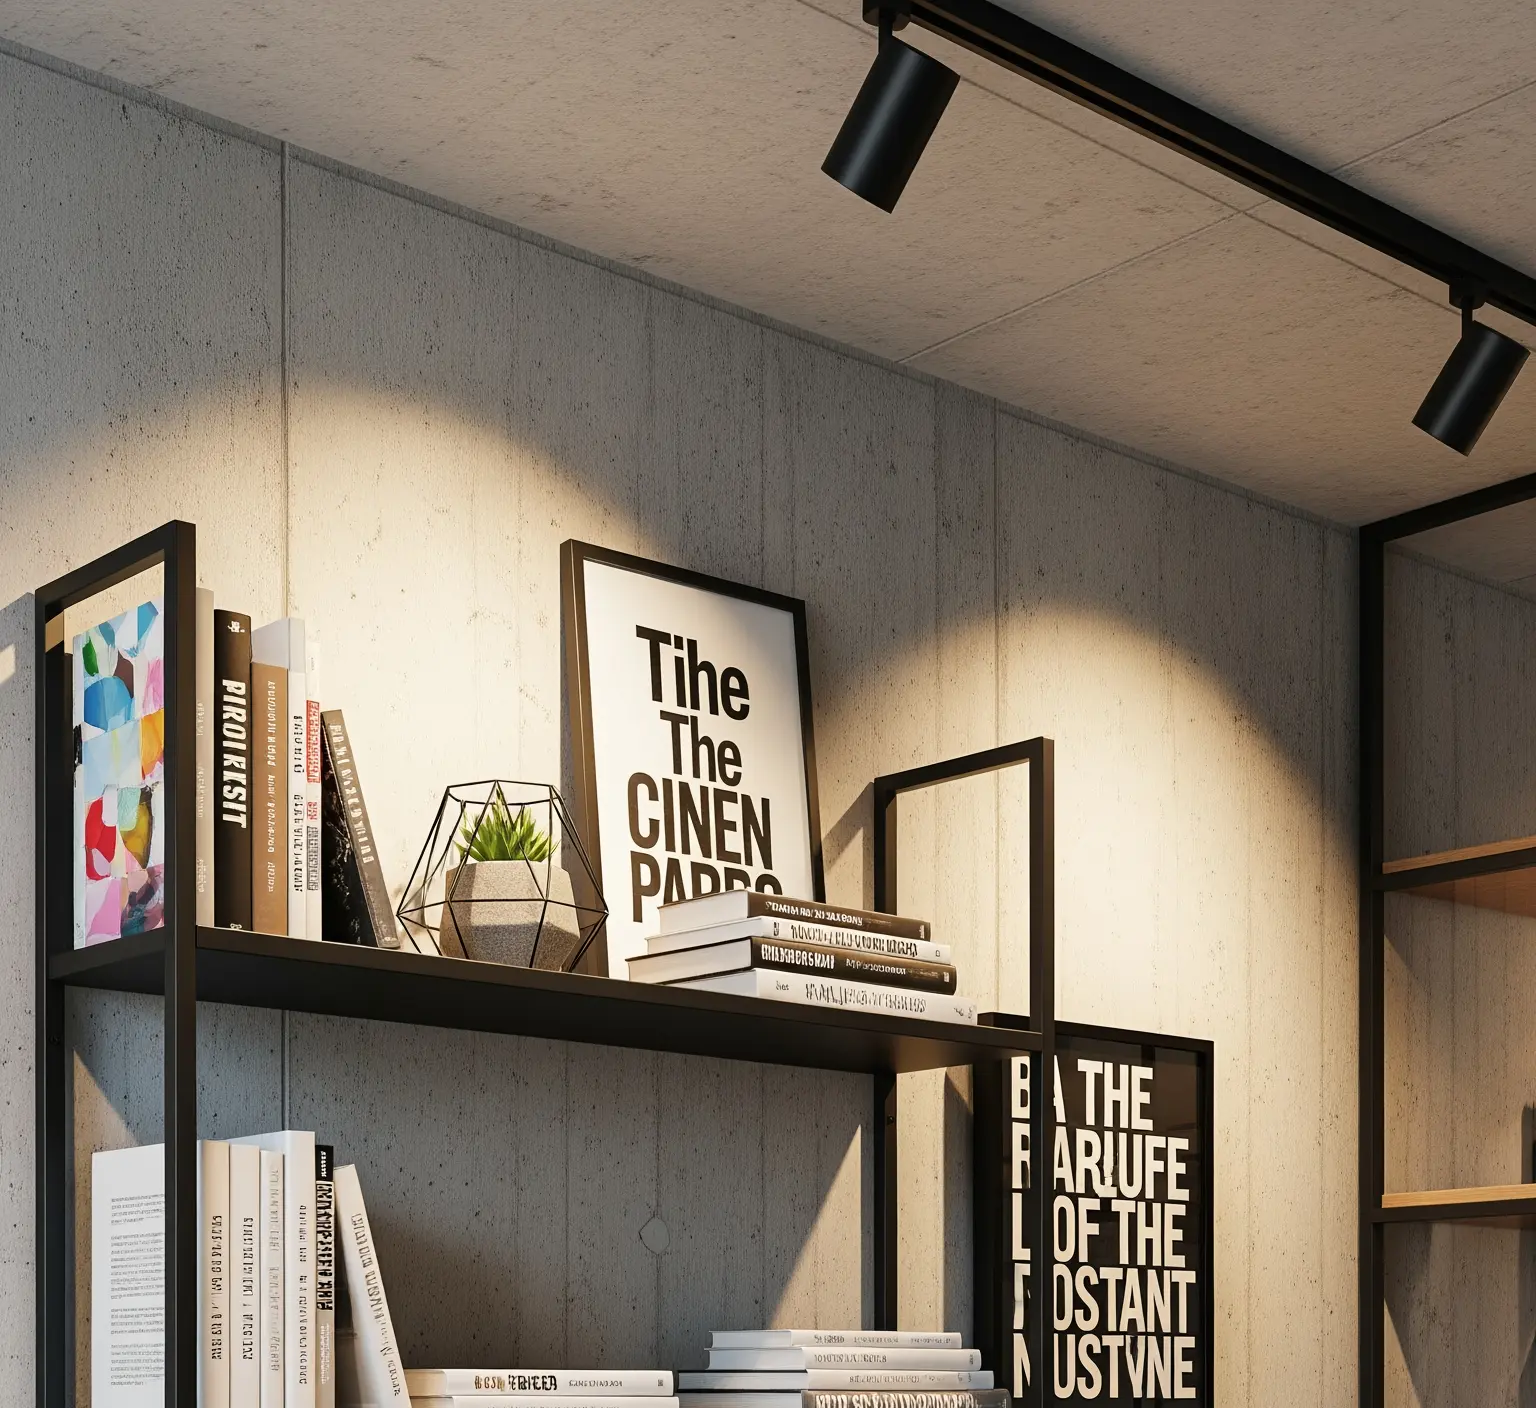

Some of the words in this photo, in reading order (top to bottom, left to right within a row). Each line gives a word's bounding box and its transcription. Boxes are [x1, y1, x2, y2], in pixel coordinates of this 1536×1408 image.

[636, 624, 750, 721] Tihe
[660, 710, 742, 787] The
[627, 772, 773, 871] CINEN
[1077, 1058, 1154, 1131] THE
[1111, 1199, 1187, 1268] THE
